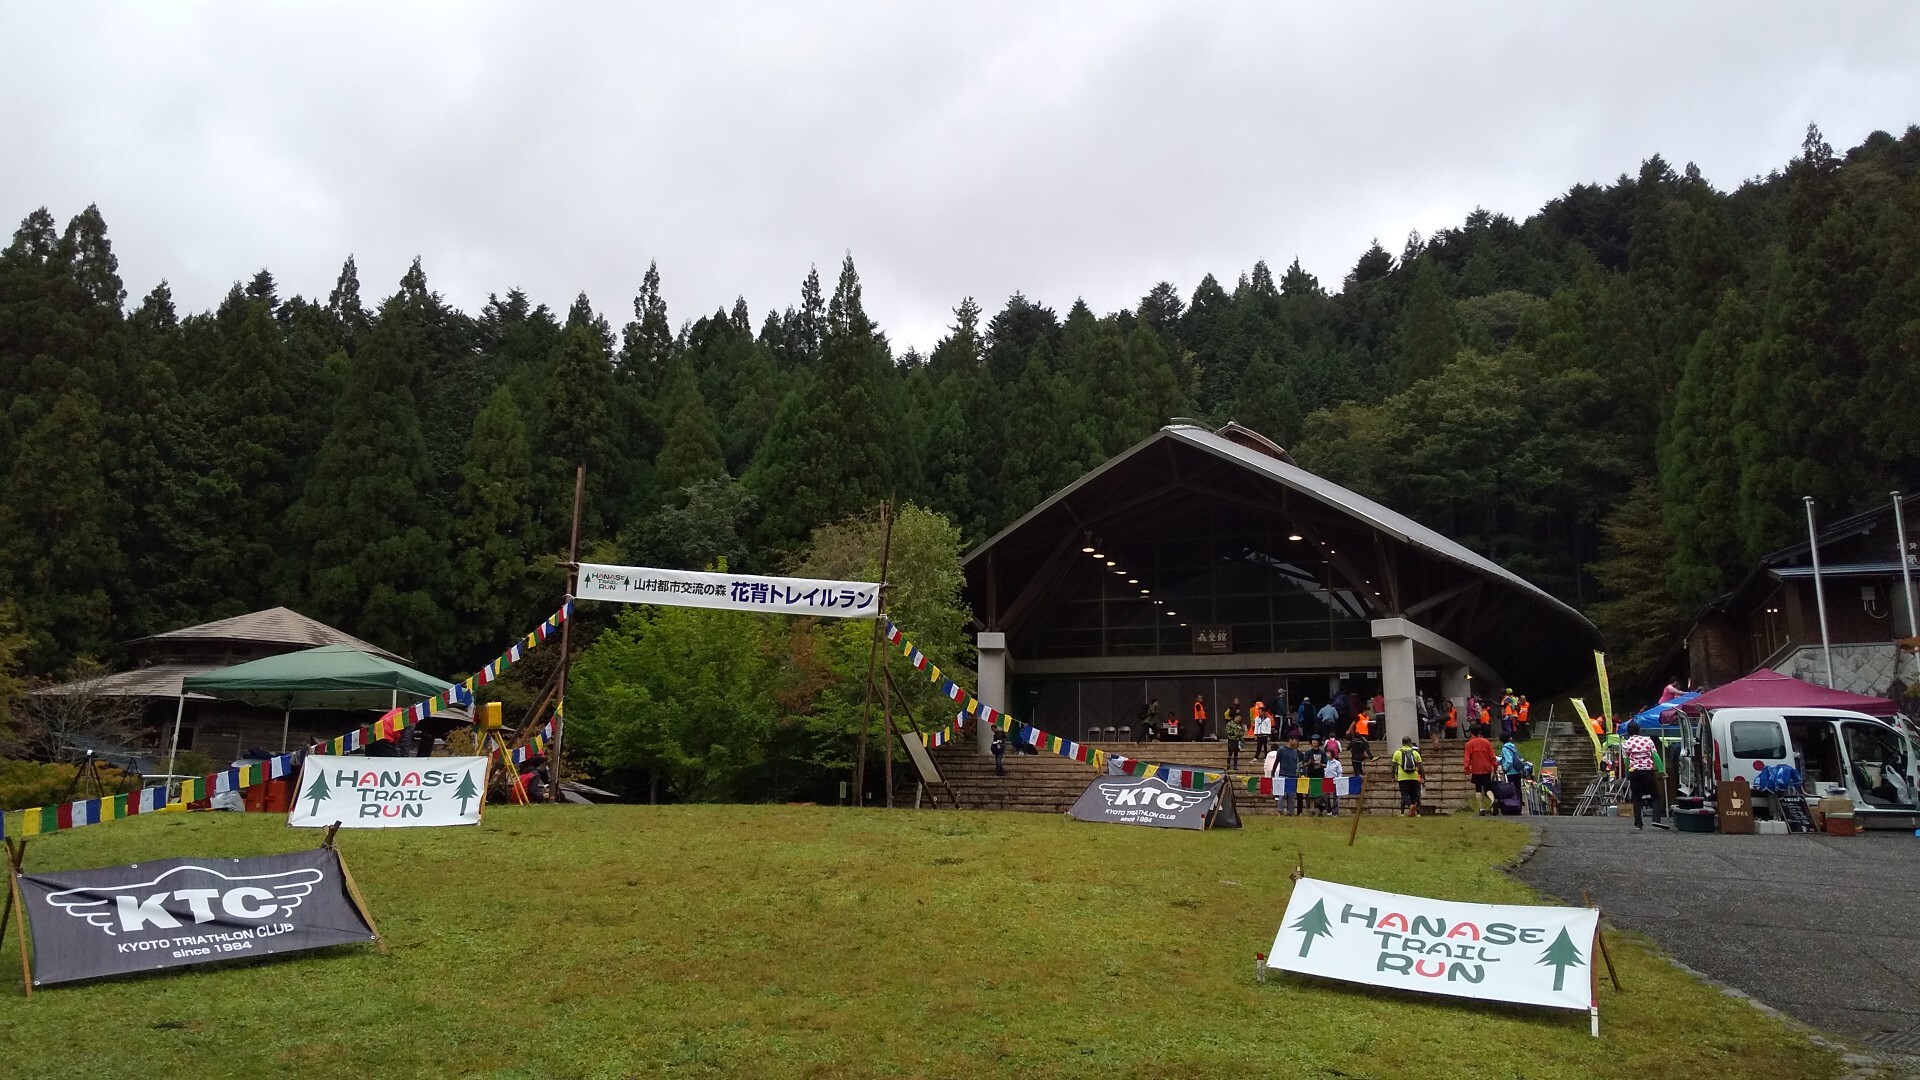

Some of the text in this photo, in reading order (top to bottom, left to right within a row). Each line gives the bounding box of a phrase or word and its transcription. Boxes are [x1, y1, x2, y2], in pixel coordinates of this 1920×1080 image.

[634, 578, 874, 609] 山村都市交流の森 花背トレイルラン
[335, 770, 458, 788] HANASE
[356, 788, 432, 802] TRAIL
[1114, 787, 1184, 810] KTC
[359, 803, 424, 819] RUN
[1105, 808, 1126, 816] KYOTO
[1126, 809, 1159, 818] TRIATHLON
[116, 887, 278, 931] KTC
[117, 922, 295, 953] KYOTO TRIATHLON CLUB
[1340, 903, 1546, 946] HANASE
[172, 940, 253, 958] since 1984
[1373, 930, 1501, 963] TRAIL
[1376, 952, 1486, 984] RUN
